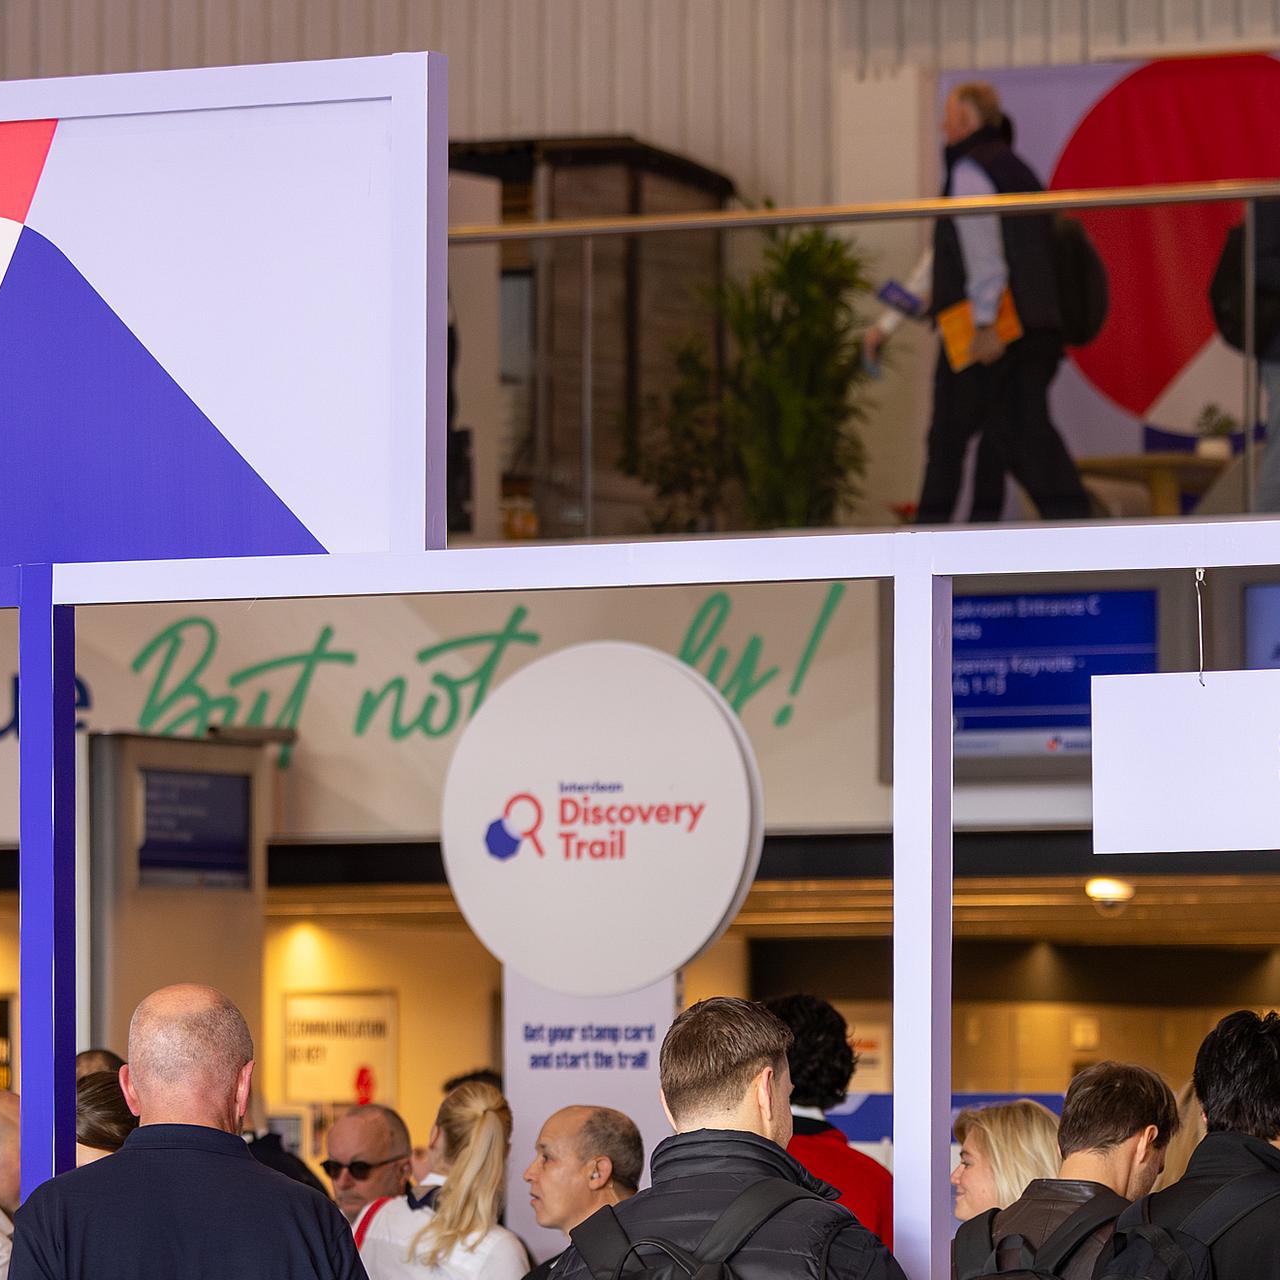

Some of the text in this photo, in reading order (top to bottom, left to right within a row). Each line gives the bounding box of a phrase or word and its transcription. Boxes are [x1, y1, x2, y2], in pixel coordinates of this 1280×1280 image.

[131, 616, 356, 769] But
[354, 606, 541, 741] not
[559, 795, 706, 834] Discovery
[558, 829, 626, 860] Trail
